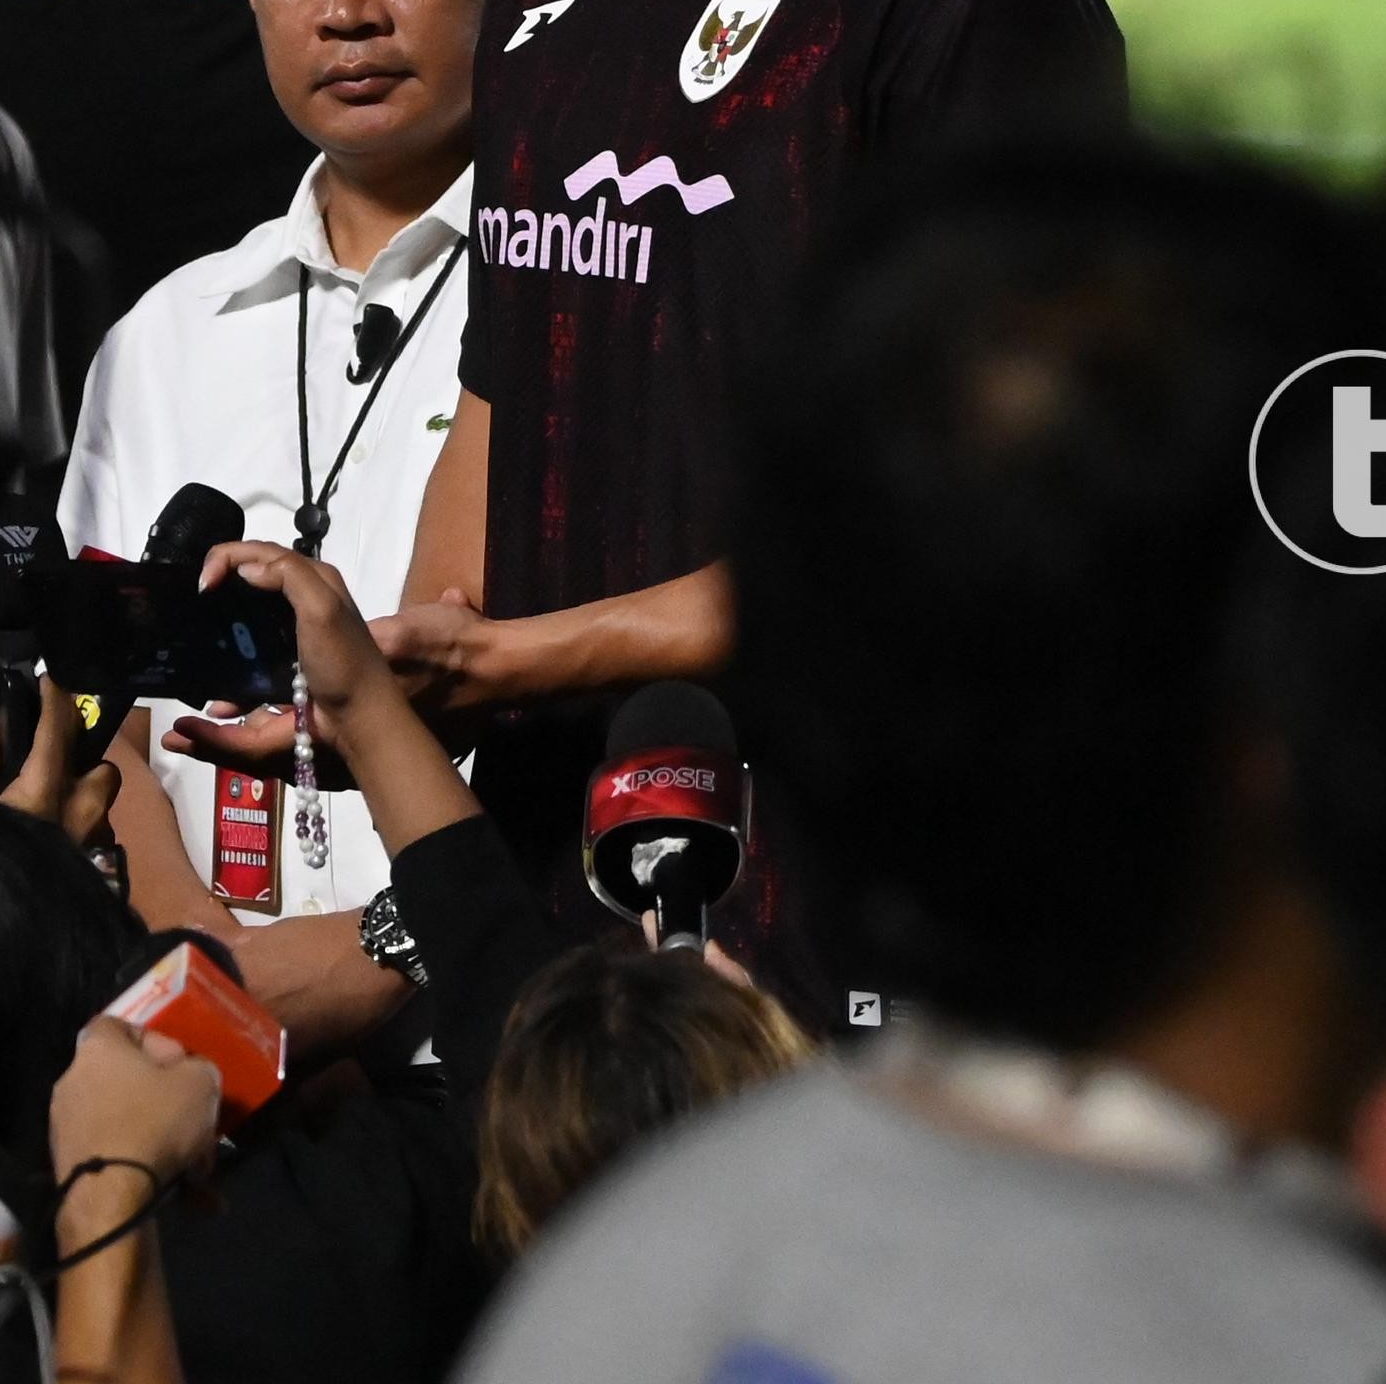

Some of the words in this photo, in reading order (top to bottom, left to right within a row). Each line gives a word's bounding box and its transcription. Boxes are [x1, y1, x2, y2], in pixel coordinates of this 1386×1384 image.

[478, 197, 653, 284] mandiri
[609, 766, 715, 798] XPOSE
[220, 849, 267, 867] INDONESIA
